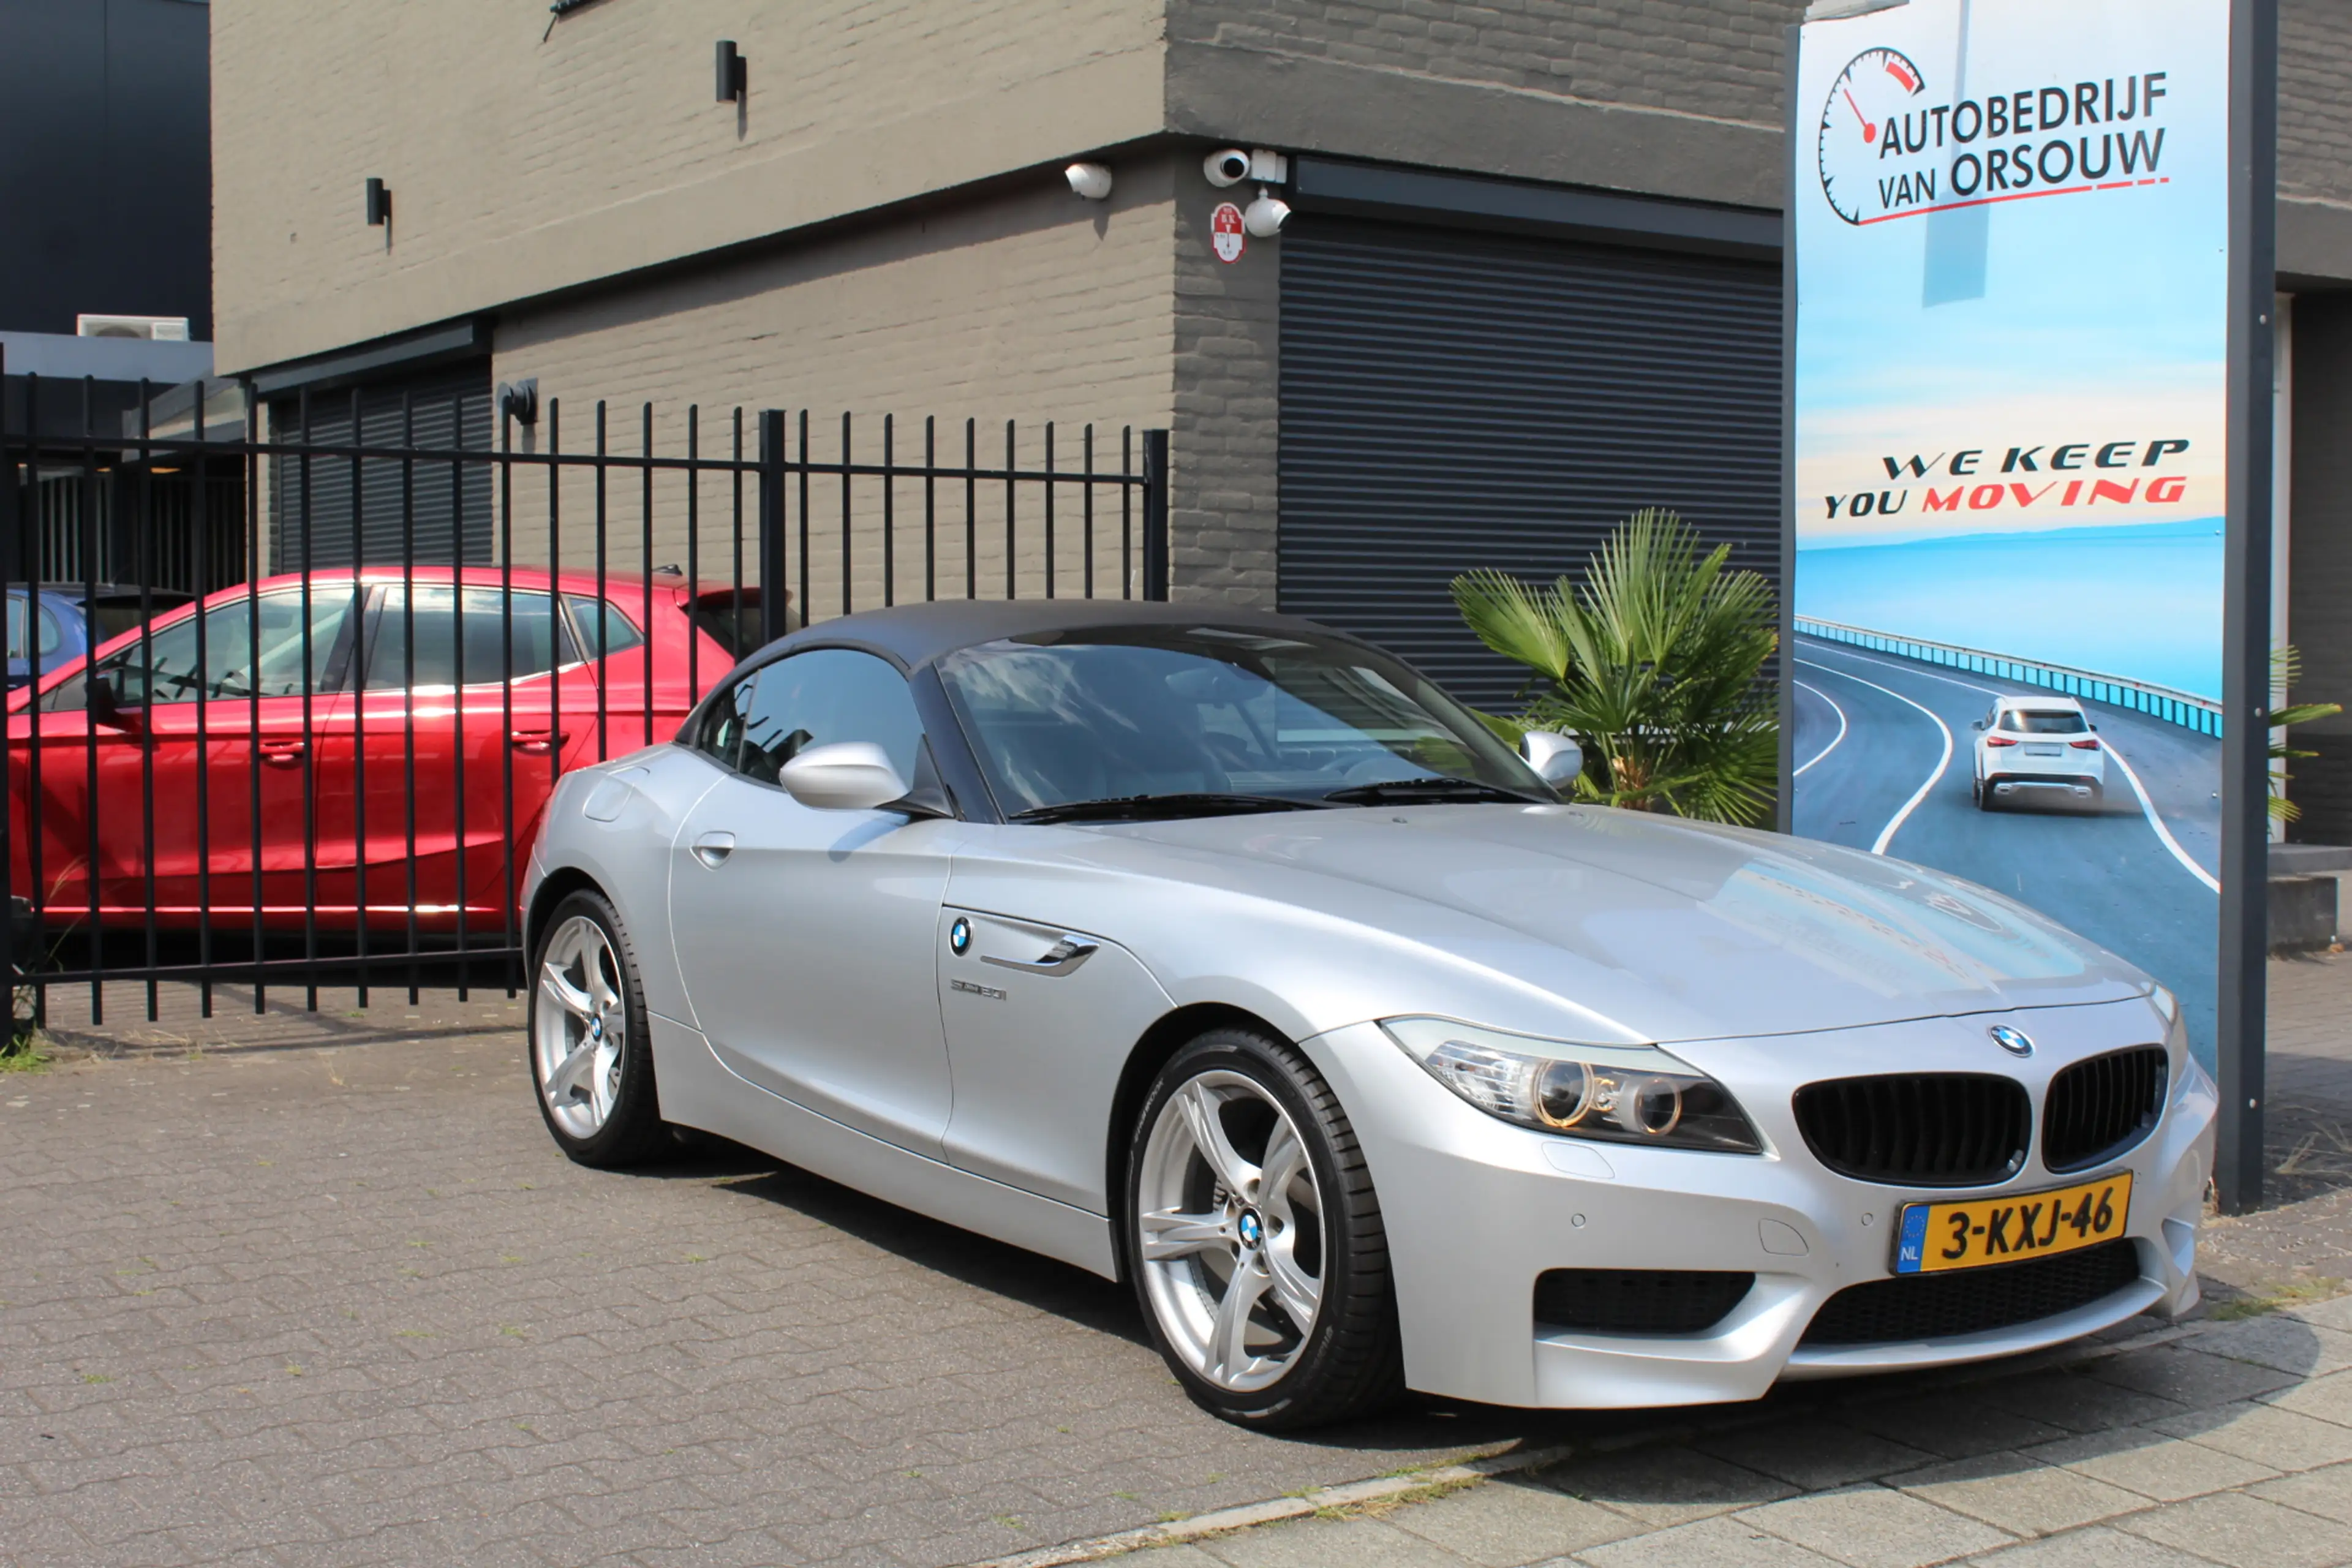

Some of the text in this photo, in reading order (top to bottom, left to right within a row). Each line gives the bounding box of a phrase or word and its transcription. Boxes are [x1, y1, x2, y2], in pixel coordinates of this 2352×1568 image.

[1880, 71, 2167, 159] AUTOBEDRIJF
[1878, 127, 2166, 209] VAN ORSOUW
[1883, 439, 2189, 480] WE KEEP
[1825, 477, 2187, 519] YOU MOVING
[1942, 1187, 2114, 1260] 3-KXJ-46
[1901, 1245, 1919, 1262] NL
